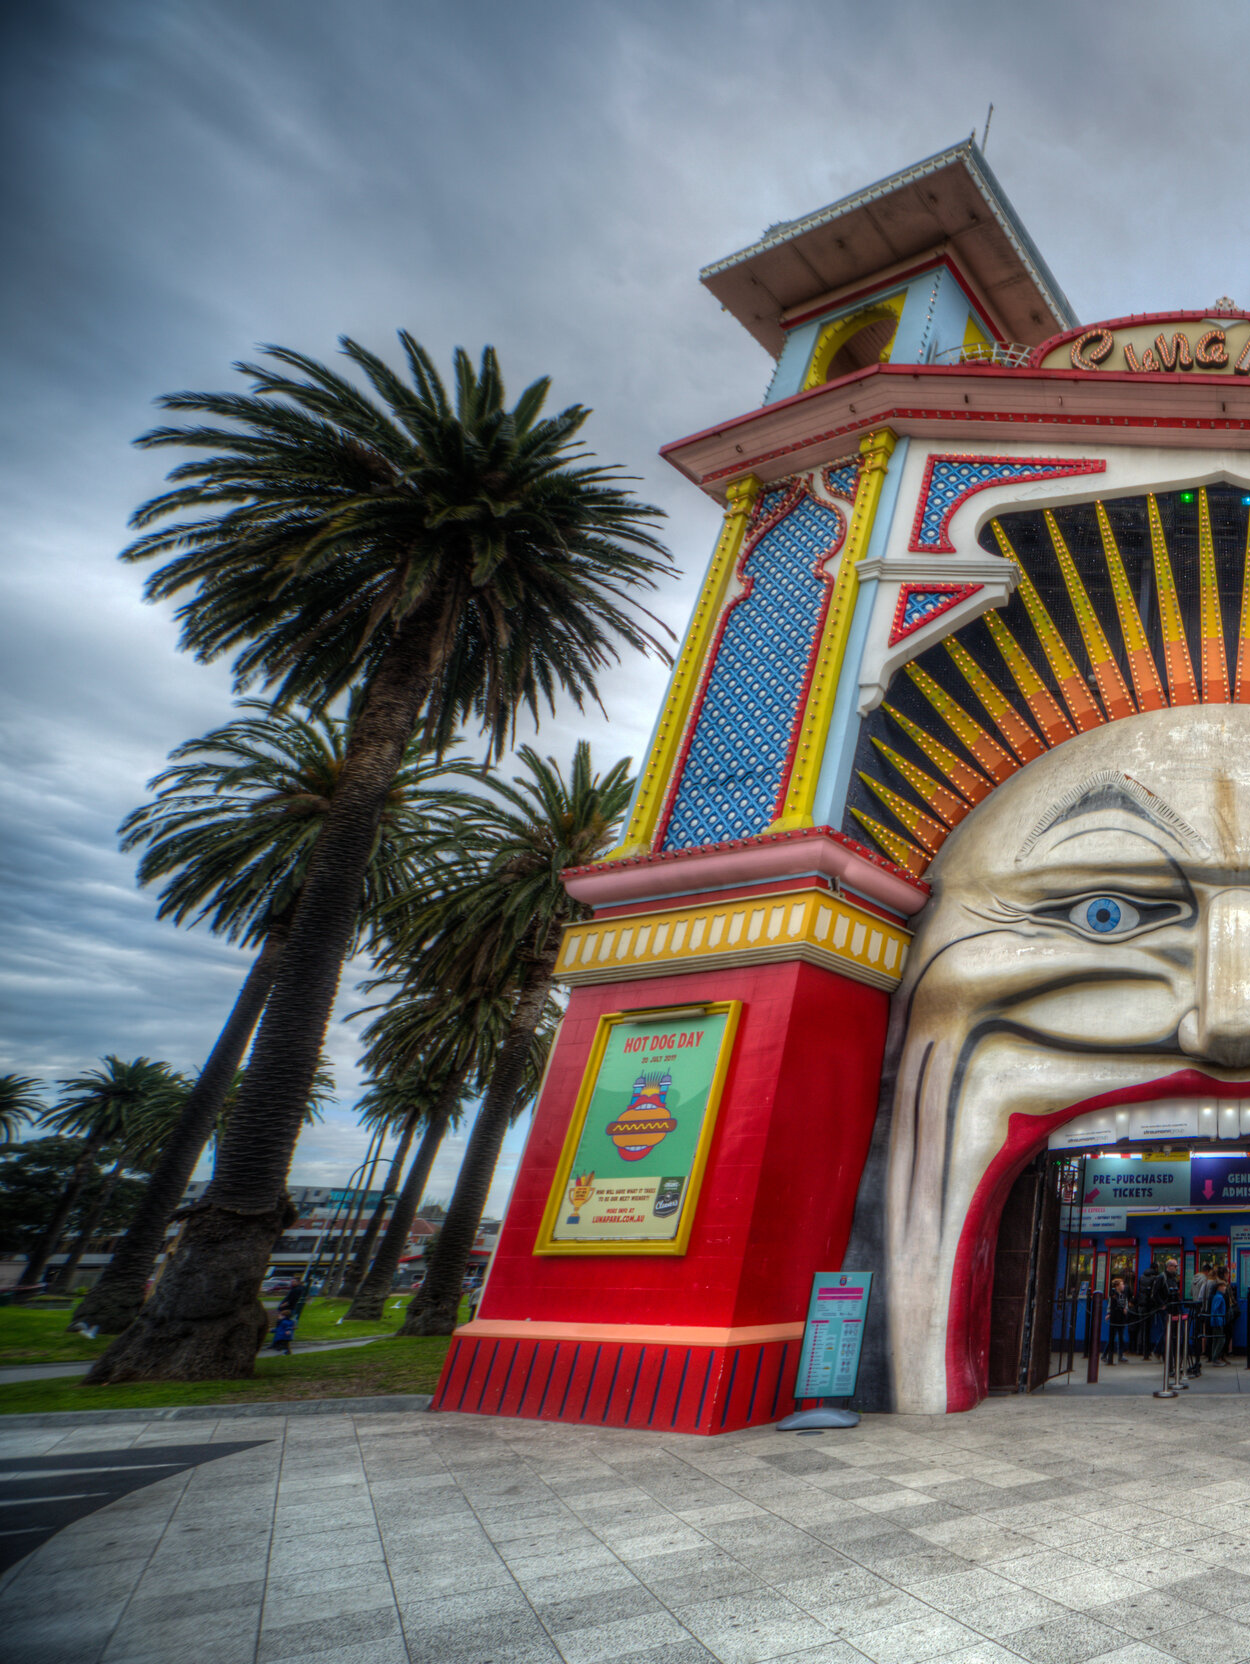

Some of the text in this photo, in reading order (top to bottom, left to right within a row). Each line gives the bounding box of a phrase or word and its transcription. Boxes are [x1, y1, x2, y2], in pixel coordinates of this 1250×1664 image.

[623, 1030, 705, 1054] HOT DOG DAY
[649, 1055, 663, 1063] JULY
[1092, 1173, 1174, 1185] PRE-PURCHASED
[1112, 1187, 1153, 1198] TICKETS
[592, 1214, 645, 1223] LUNAPARK.COM.AU
